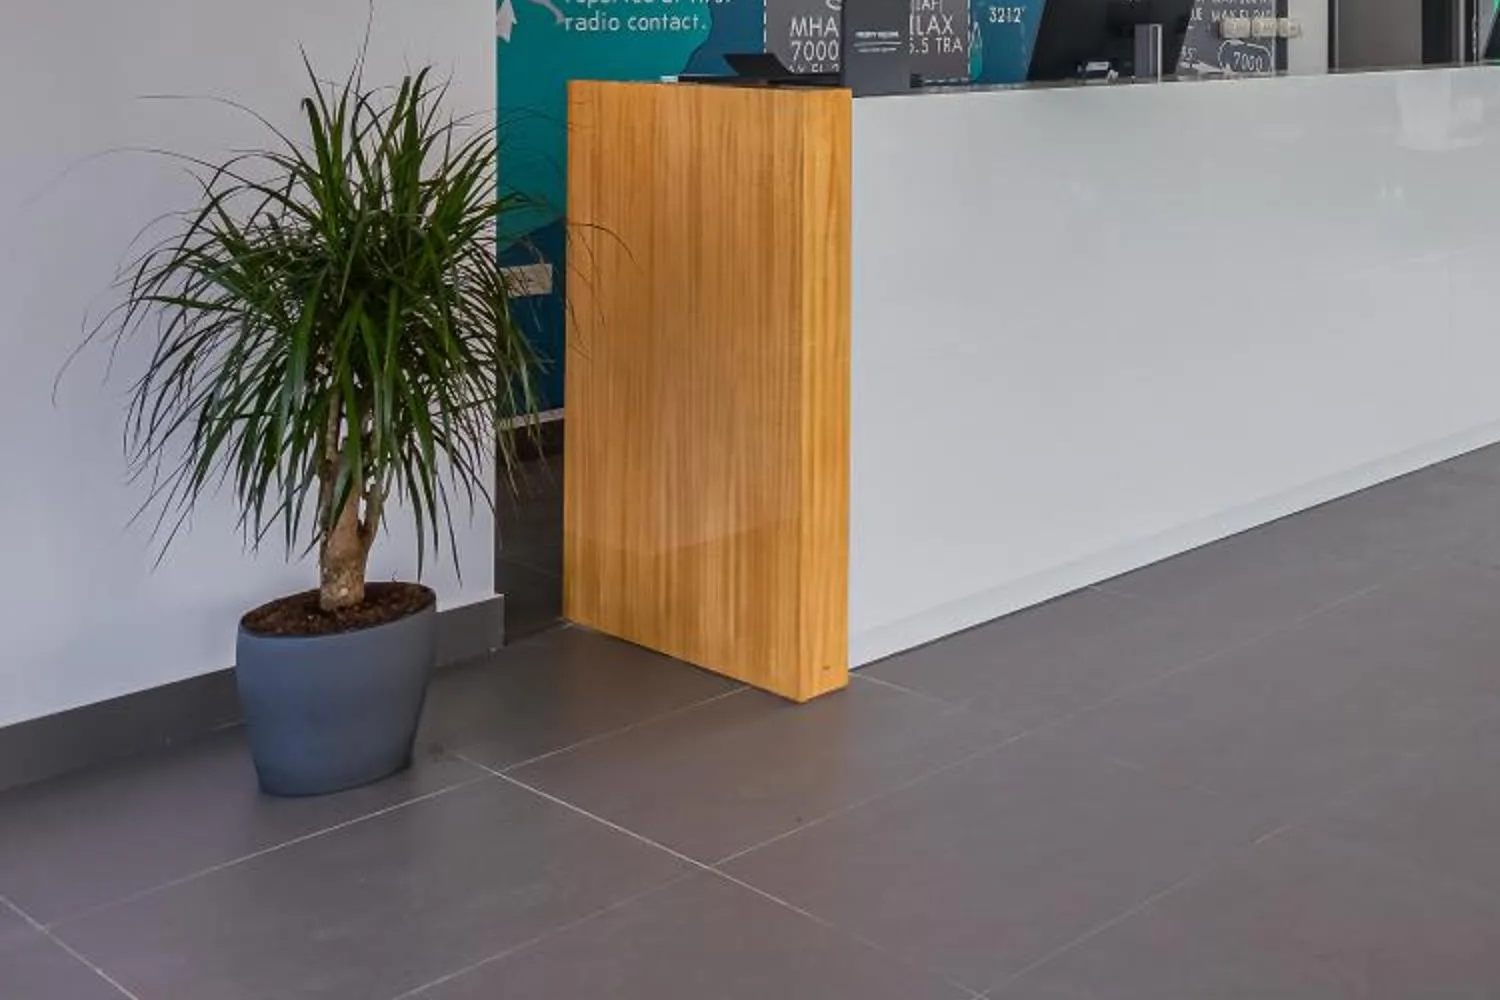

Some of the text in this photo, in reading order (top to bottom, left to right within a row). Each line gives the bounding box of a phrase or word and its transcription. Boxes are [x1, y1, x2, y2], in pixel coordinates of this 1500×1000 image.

[565, 10, 706, 32] radio contact.
[789, 16, 839, 38] MHA
[790, 39, 839, 62] 7000
